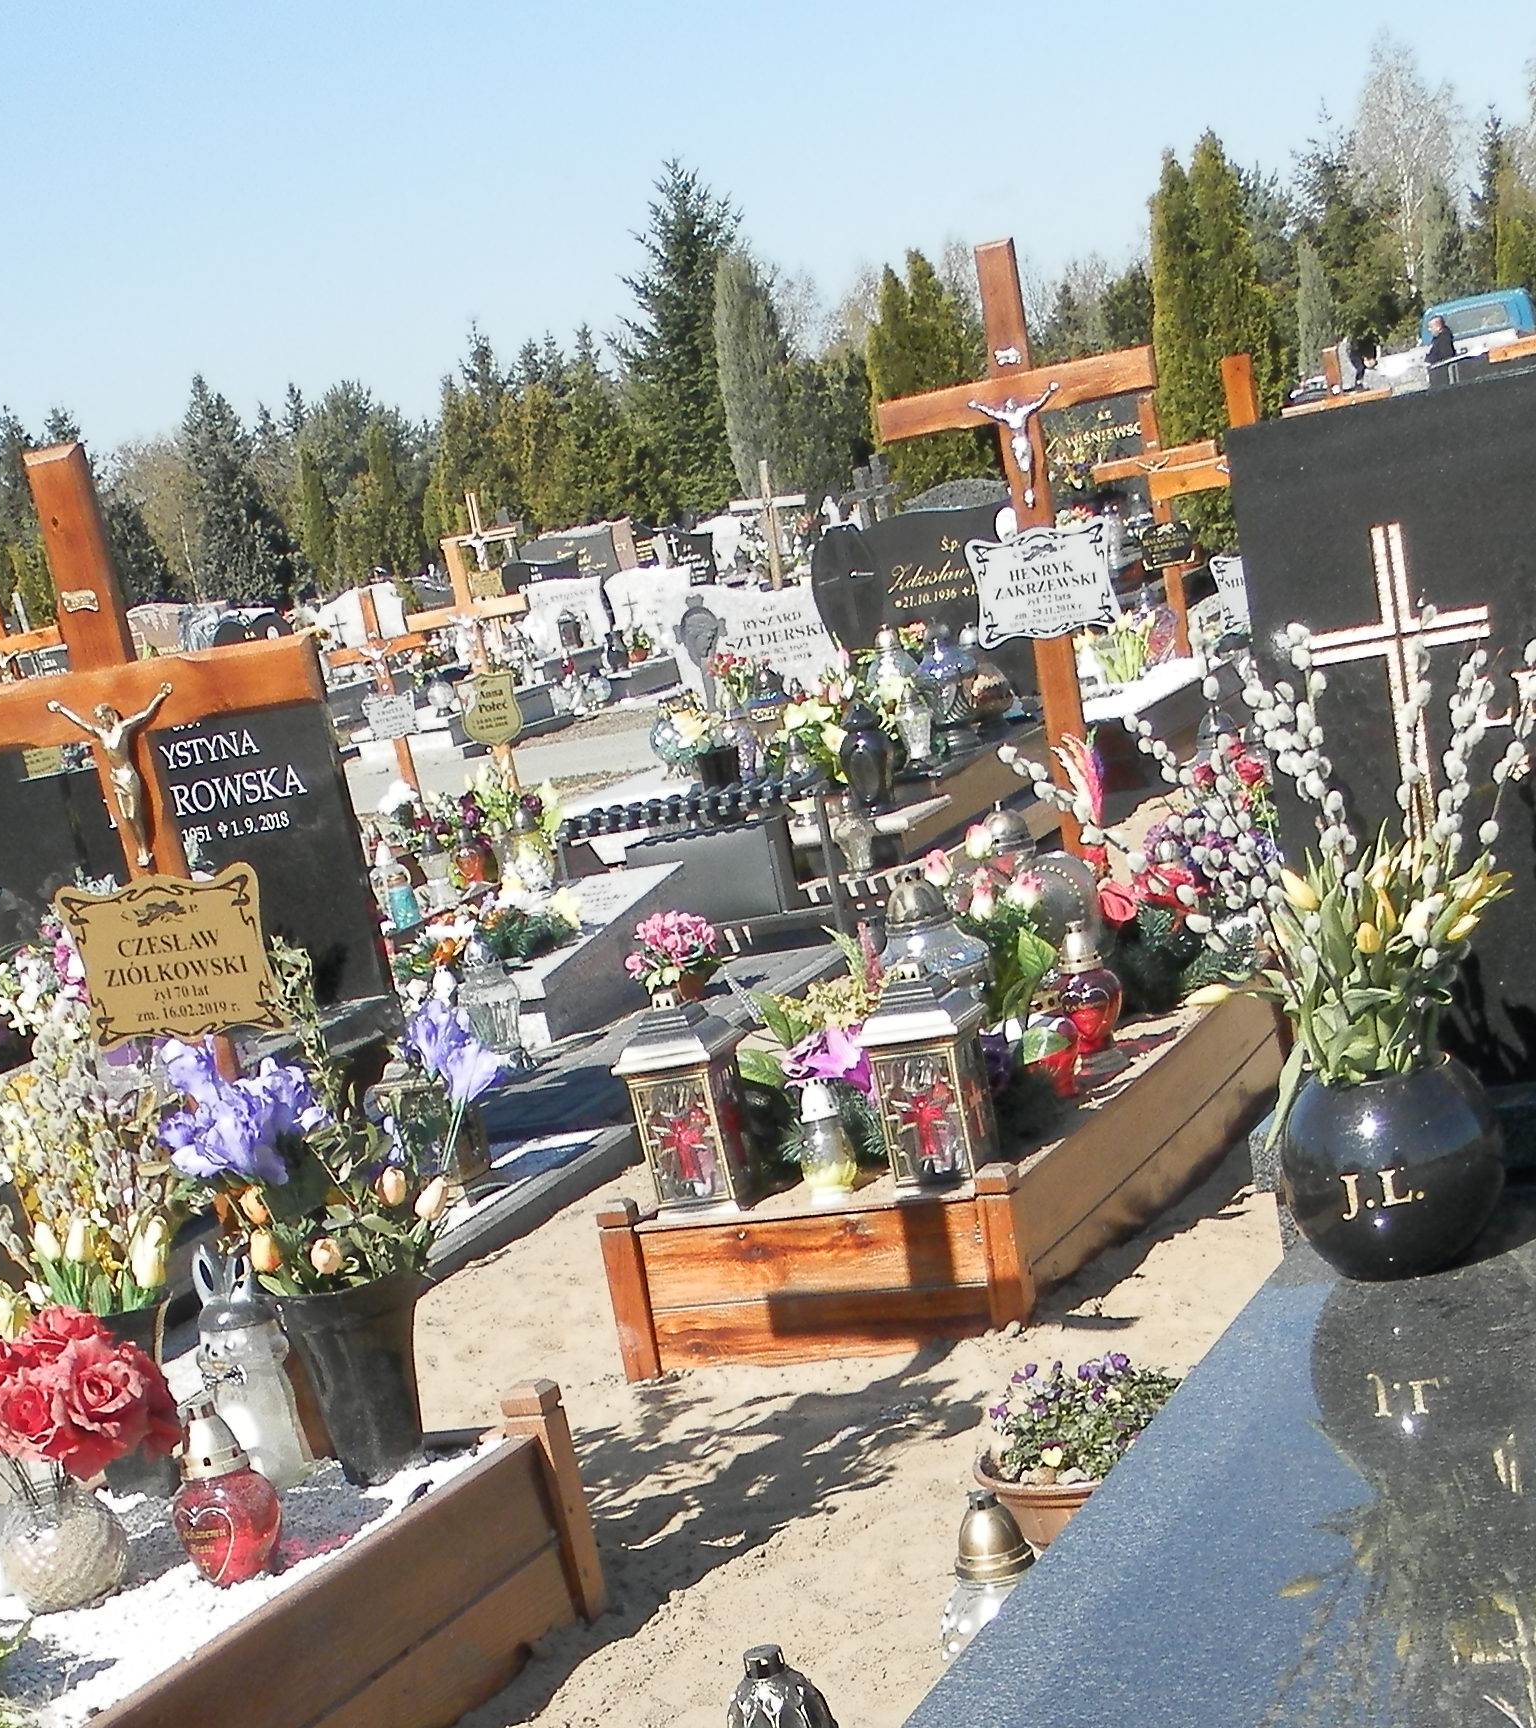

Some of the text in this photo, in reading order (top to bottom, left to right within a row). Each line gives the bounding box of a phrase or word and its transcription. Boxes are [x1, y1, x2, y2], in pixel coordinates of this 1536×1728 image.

[1009, 560, 1074, 582] HENRYK
[995, 572, 1097, 600] ZAKRZEWSKI
[742, 611, 802, 631] RYSZARD
[159, 728, 260, 770] YSTYNA
[169, 764, 308, 817] ROWSKA
[117, 928, 220, 958] CZESŁAW
[104, 955, 249, 987] ZIÓŁKOWSKI
[154, 984, 210, 1003] żył 70 lat
[137, 1011, 160, 1023] zm.
[162, 1001, 227, 1021] 16.02.2019
